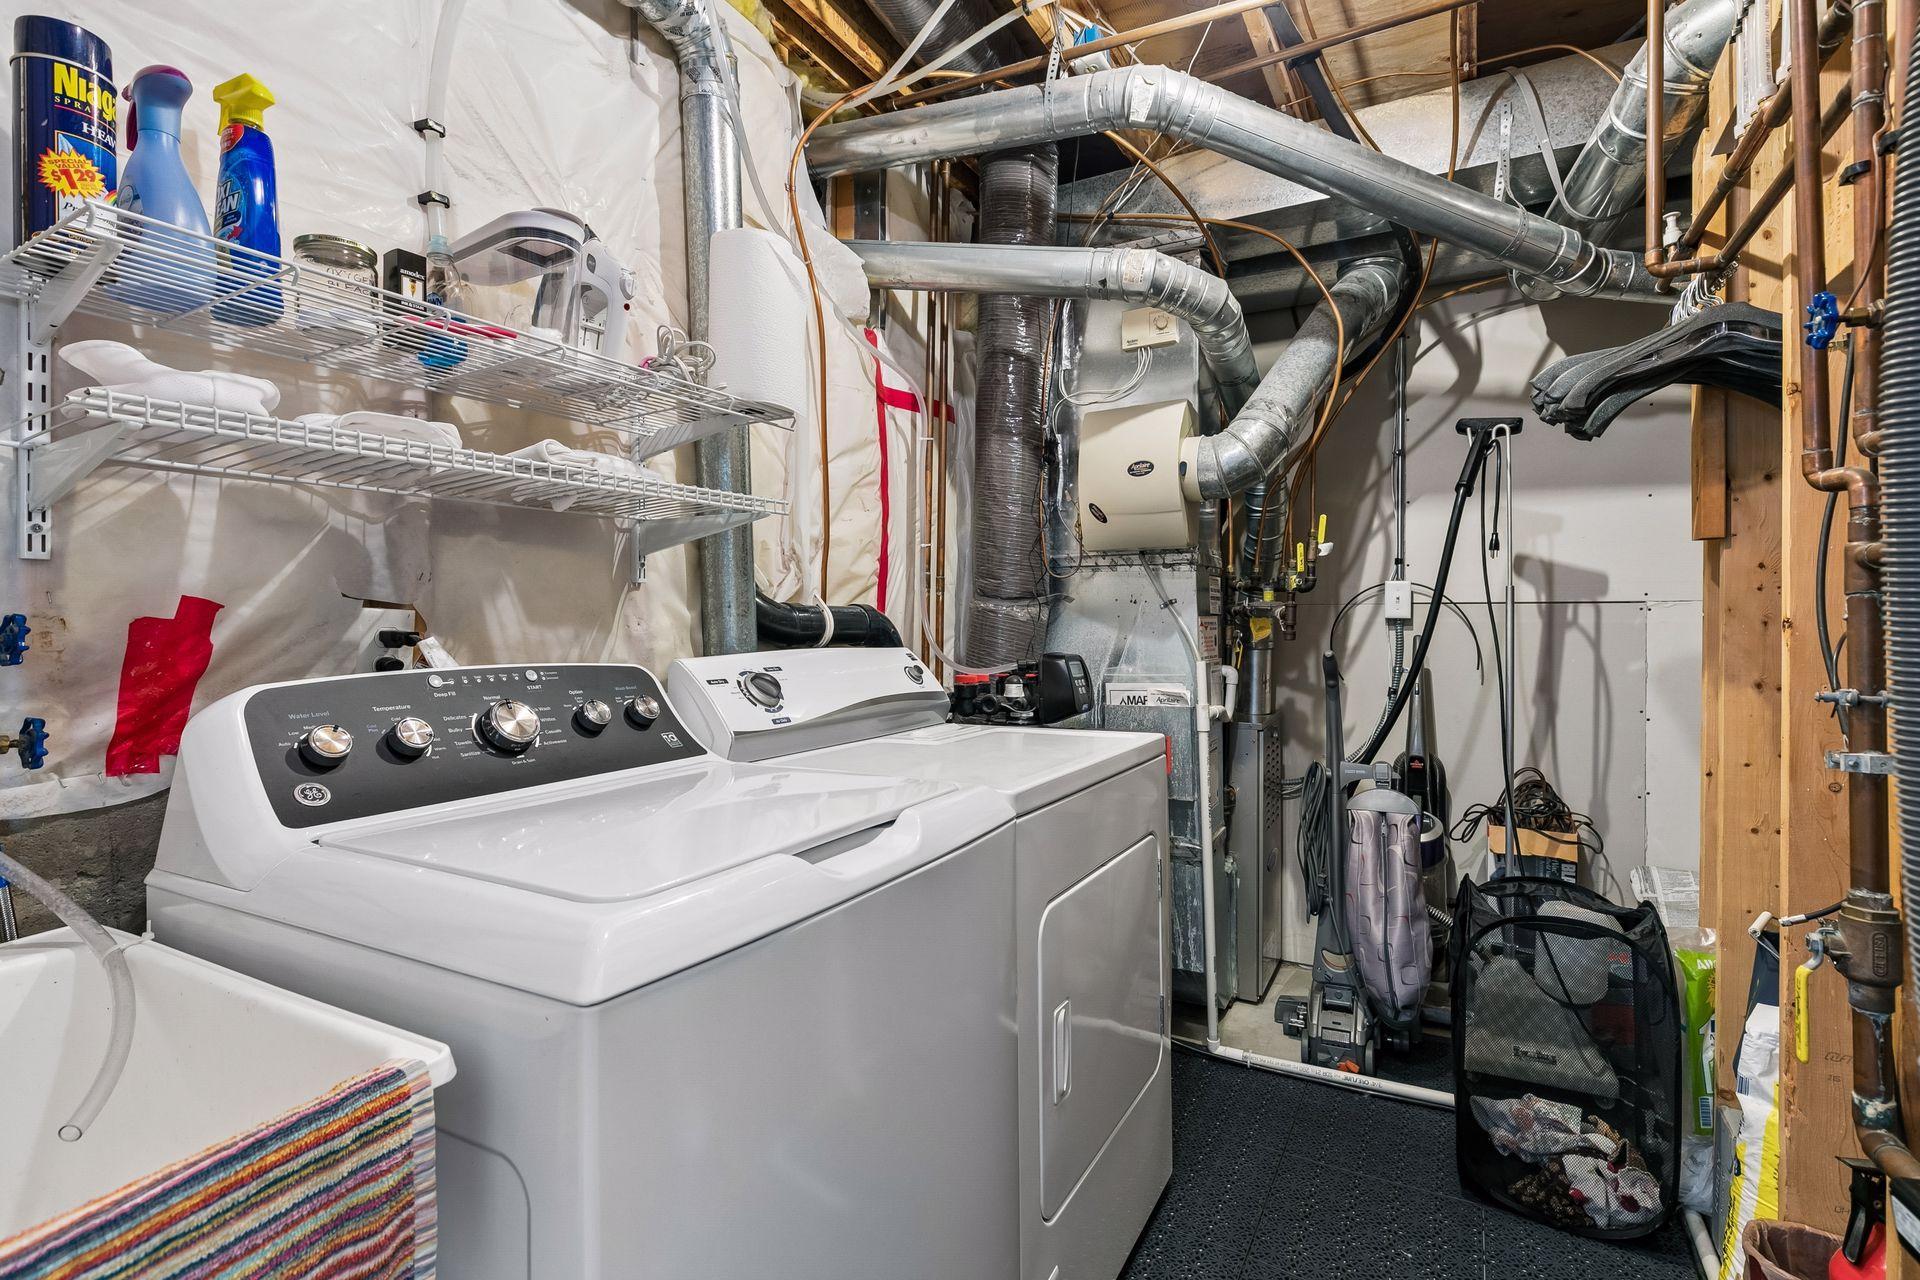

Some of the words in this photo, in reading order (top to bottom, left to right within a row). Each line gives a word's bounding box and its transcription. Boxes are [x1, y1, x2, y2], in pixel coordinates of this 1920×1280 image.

[54, 95, 92, 113] SPRA
[81, 121, 116, 149] HEAV
[217, 181, 232, 198] XI
[400, 268, 426, 281] amodex
[327, 280, 371, 296] BLEAC
[287, 712, 310, 720] Water
[310, 710, 330, 718] Level
[372, 704, 411, 712] Temperature
